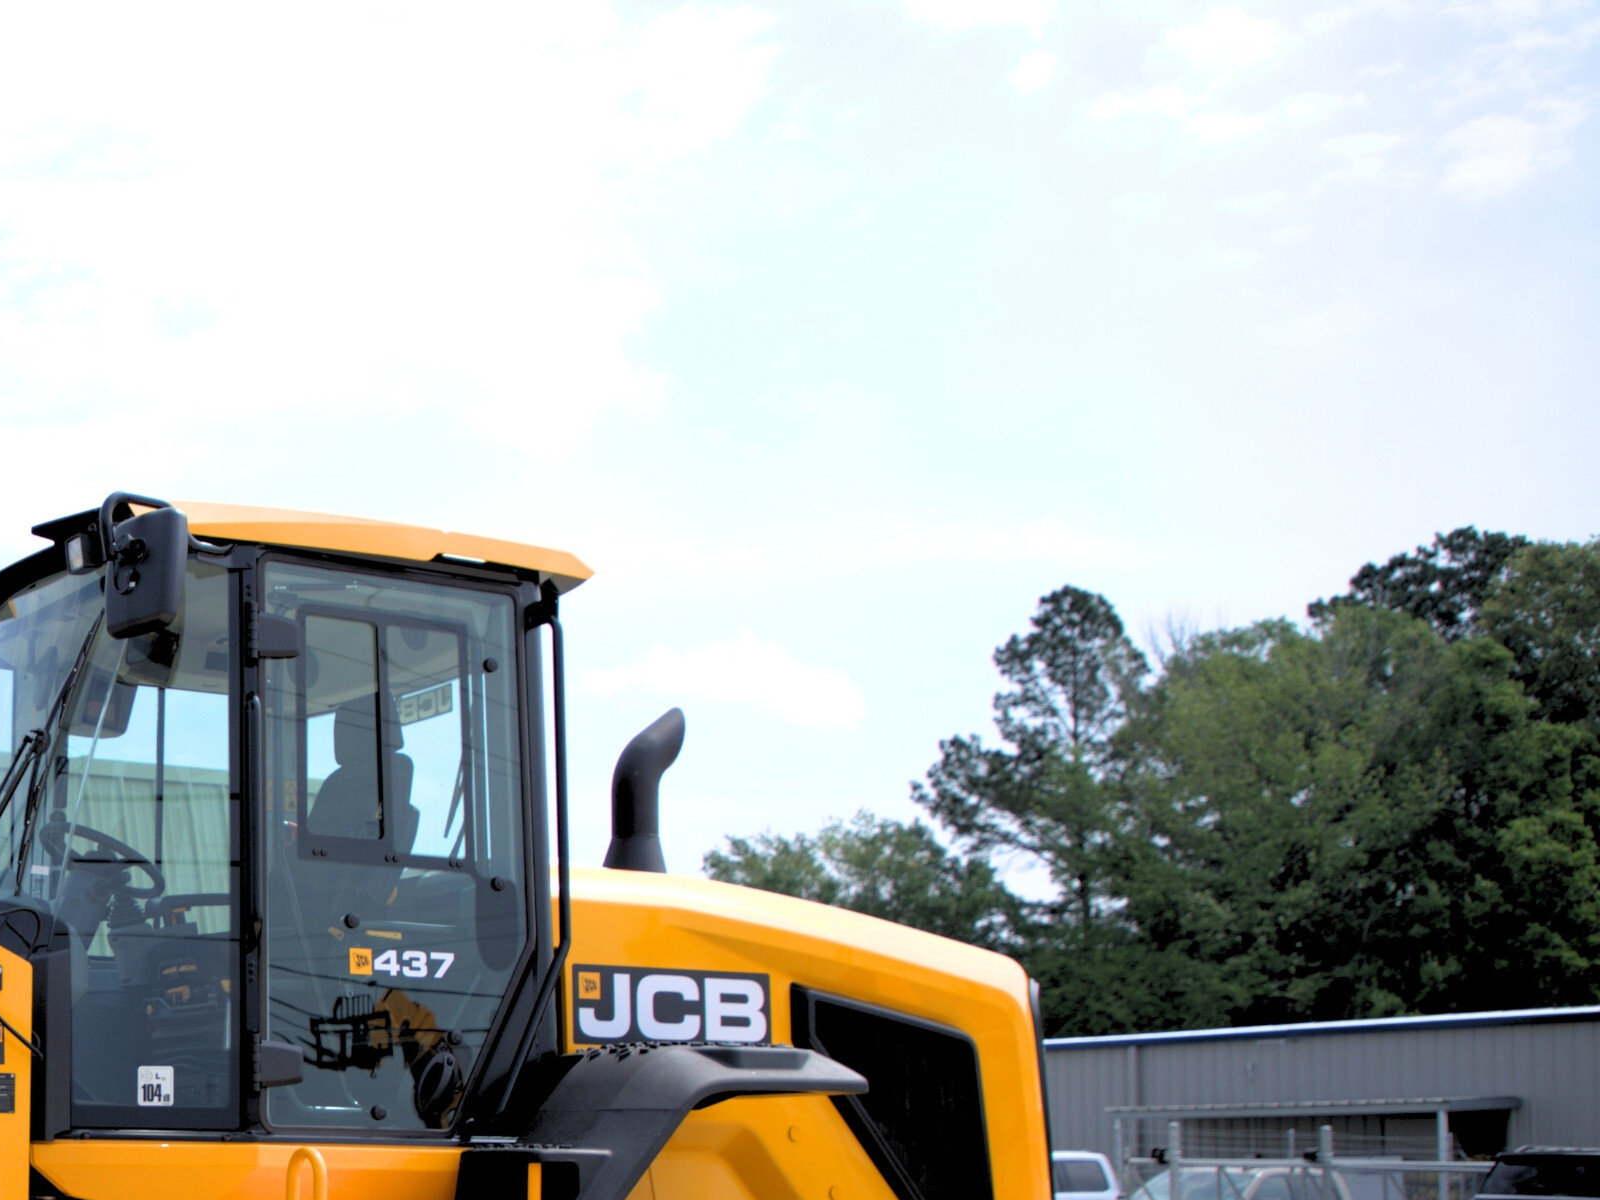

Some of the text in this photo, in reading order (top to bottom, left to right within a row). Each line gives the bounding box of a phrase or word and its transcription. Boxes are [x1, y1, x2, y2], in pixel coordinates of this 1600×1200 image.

[373, 950, 455, 979] 437
[578, 973, 767, 1043] JCB
[141, 1083, 162, 1102] 104
